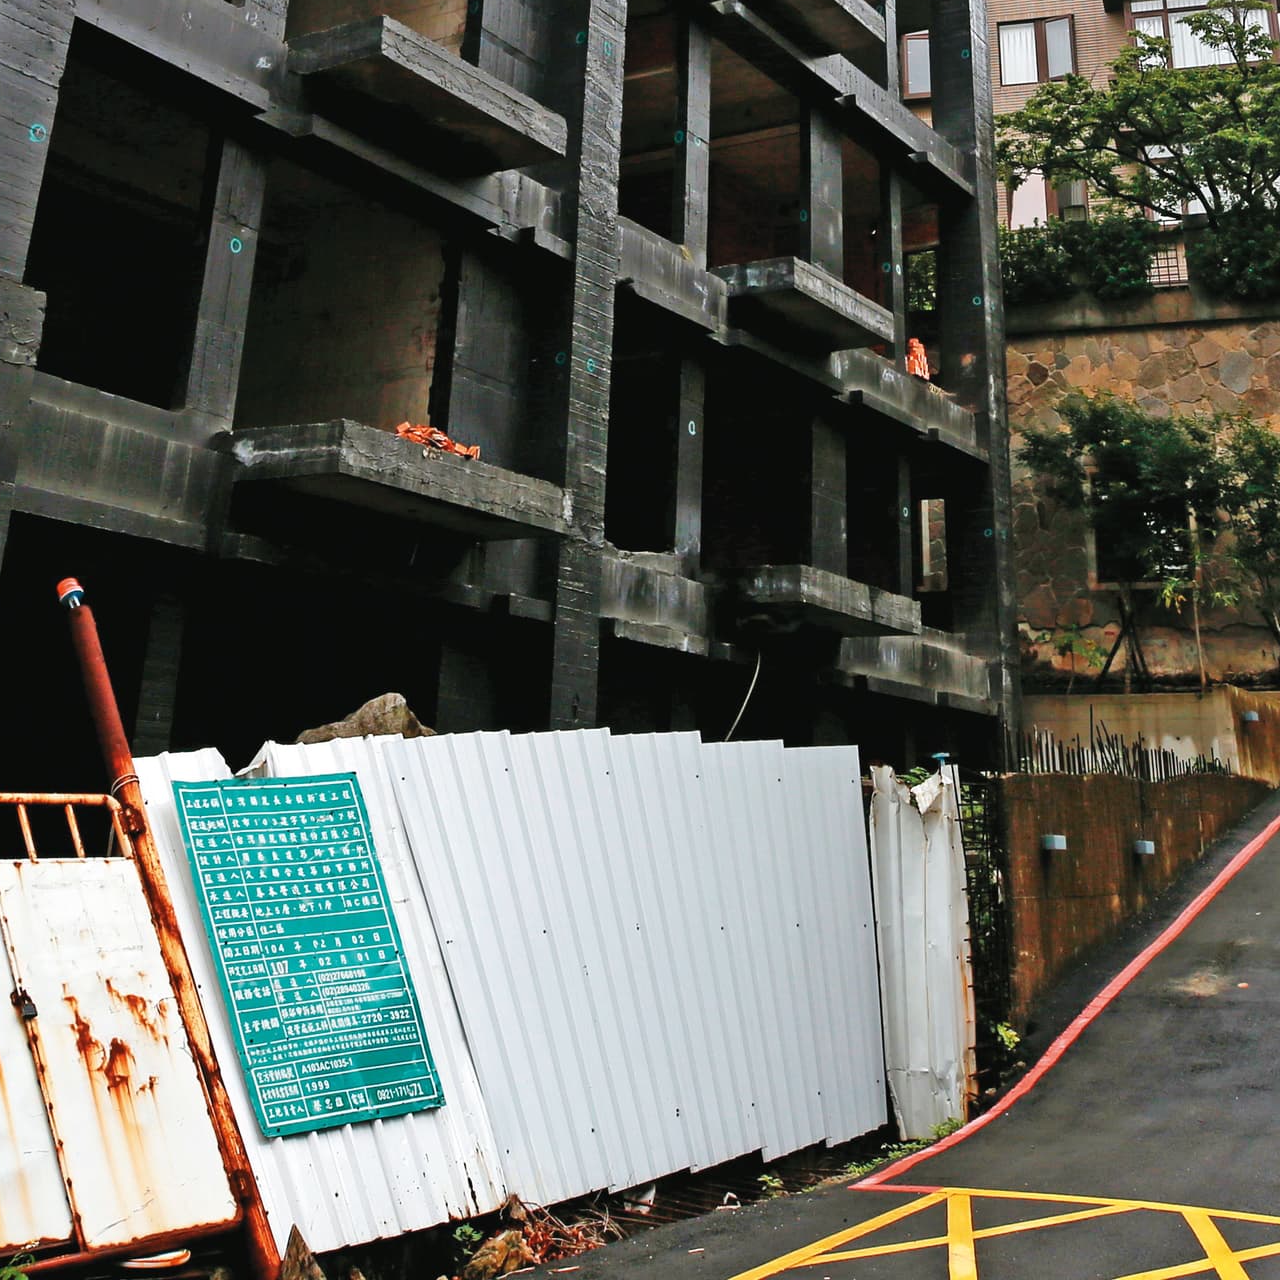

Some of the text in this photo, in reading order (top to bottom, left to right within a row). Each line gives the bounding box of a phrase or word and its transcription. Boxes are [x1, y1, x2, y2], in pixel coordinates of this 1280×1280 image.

[209, 890, 245, 902] 承造人
[217, 925, 255, 939] 使用分區
[259, 923, 285, 935] 住二區
[223, 944, 261, 958] 開工日期
[234, 985, 271, 1001] 服務電話
[244, 1017, 280, 1034] 主管機關
[301, 1057, 353, 1074] A103AC1035-1
[305, 1079, 330, 1092] 1999
[268, 1104, 305, 1119] 工地負責人
